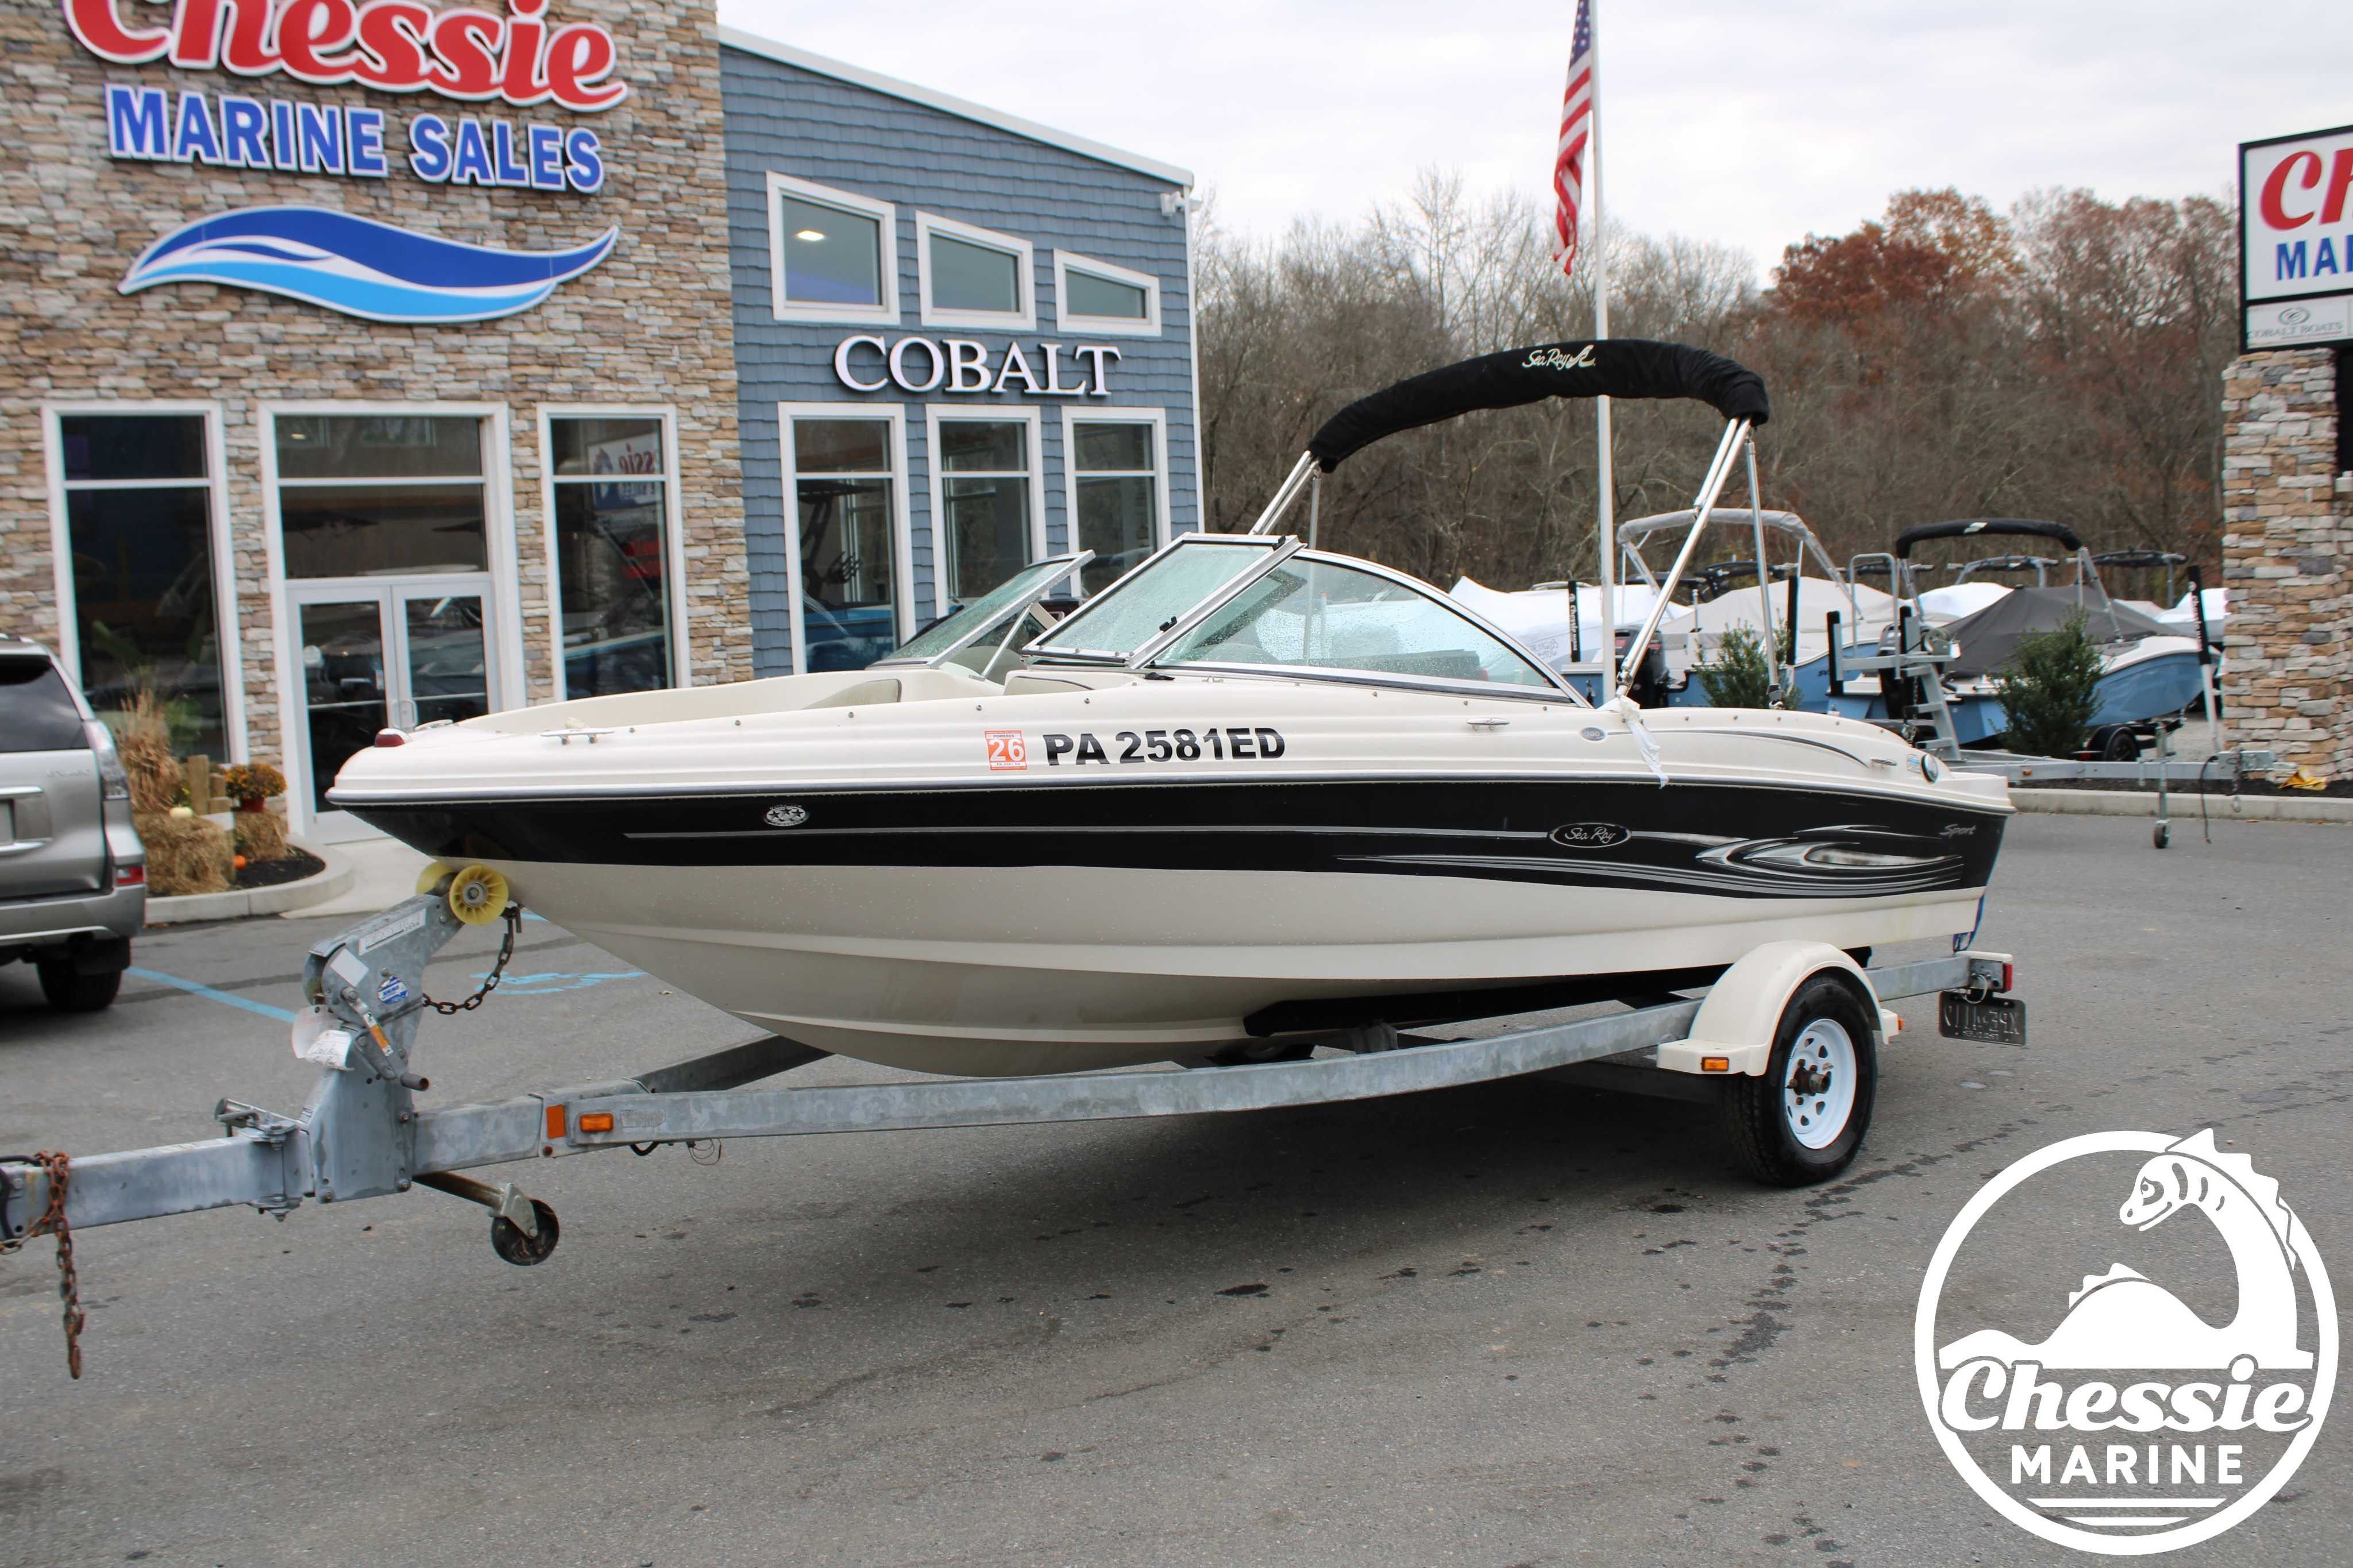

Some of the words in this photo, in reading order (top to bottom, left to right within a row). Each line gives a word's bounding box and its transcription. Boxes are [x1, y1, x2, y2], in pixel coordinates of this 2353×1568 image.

[105, 84, 388, 177] MARINE
[410, 114, 605, 194] SALES
[834, 334, 1122, 397] COBALT
[1522, 349, 1547, 368] Sea
[1545, 348, 1571, 371] Ray
[988, 739, 1025, 762] 26
[1042, 733, 1111, 766] PA
[1115, 727, 1286, 764] 2581ED
[1564, 827, 1589, 840] Sea
[1590, 827, 1617, 844] Ray
[1939, 823, 1977, 839] Sport
